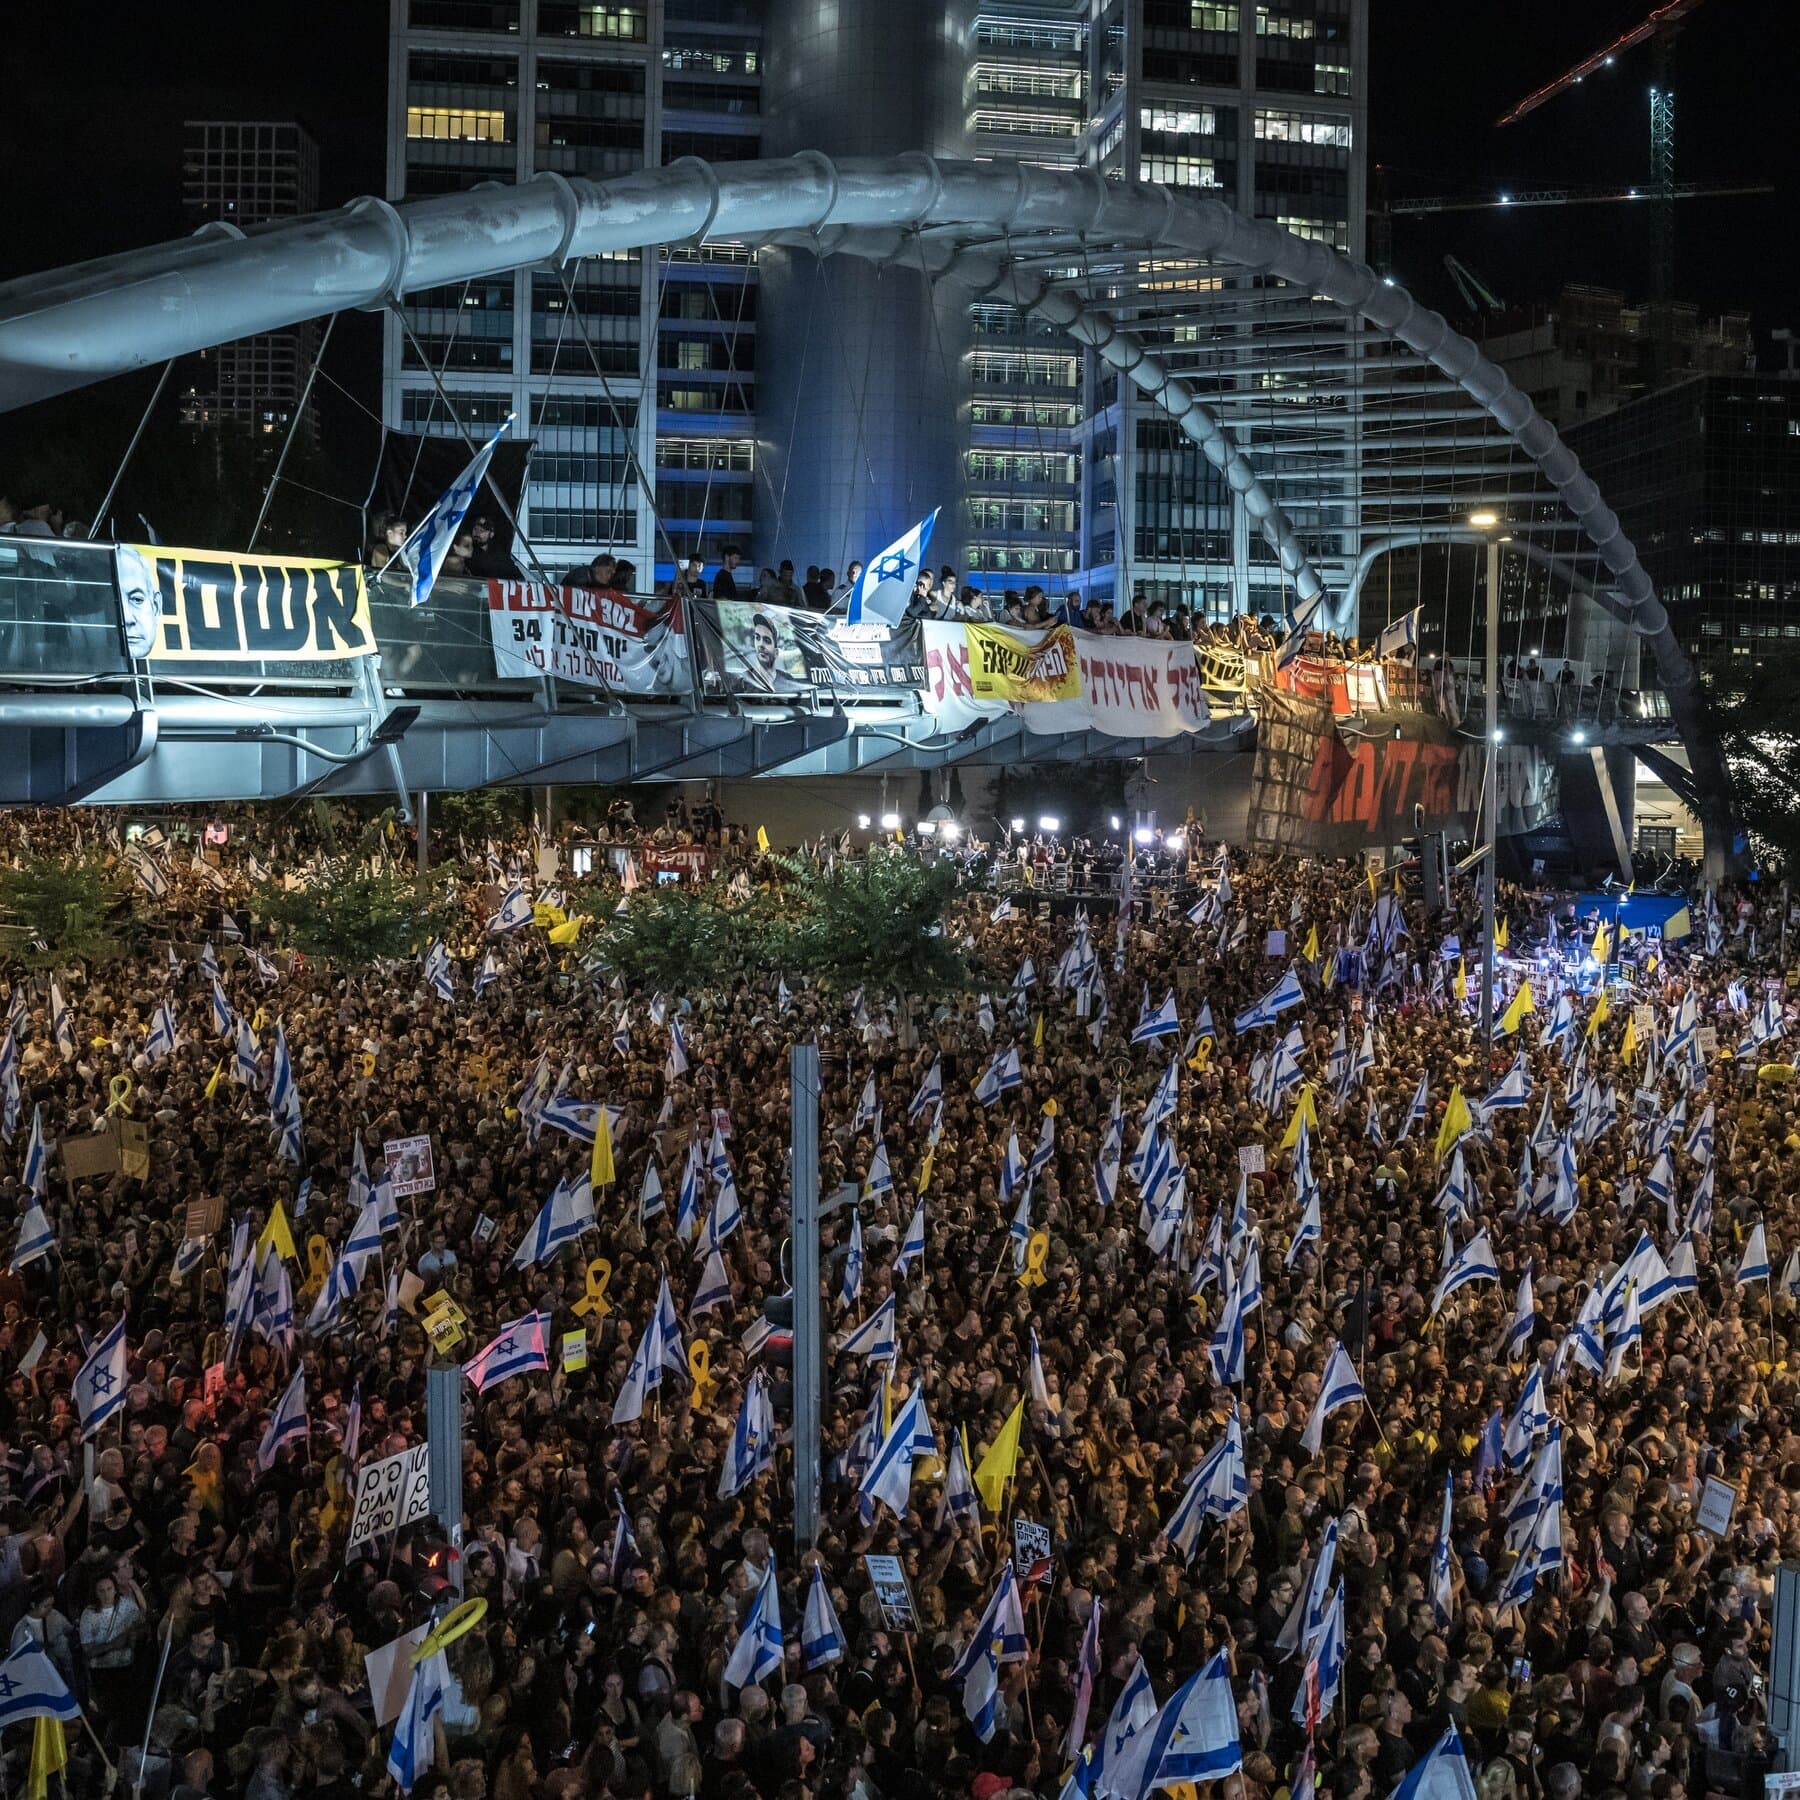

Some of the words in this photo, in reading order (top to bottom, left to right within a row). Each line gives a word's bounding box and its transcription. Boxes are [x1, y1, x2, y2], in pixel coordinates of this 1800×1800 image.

[571, 587, 597, 618] יום
[512, 619, 542, 642] 34
[585, 656, 625, 683] מחכם
